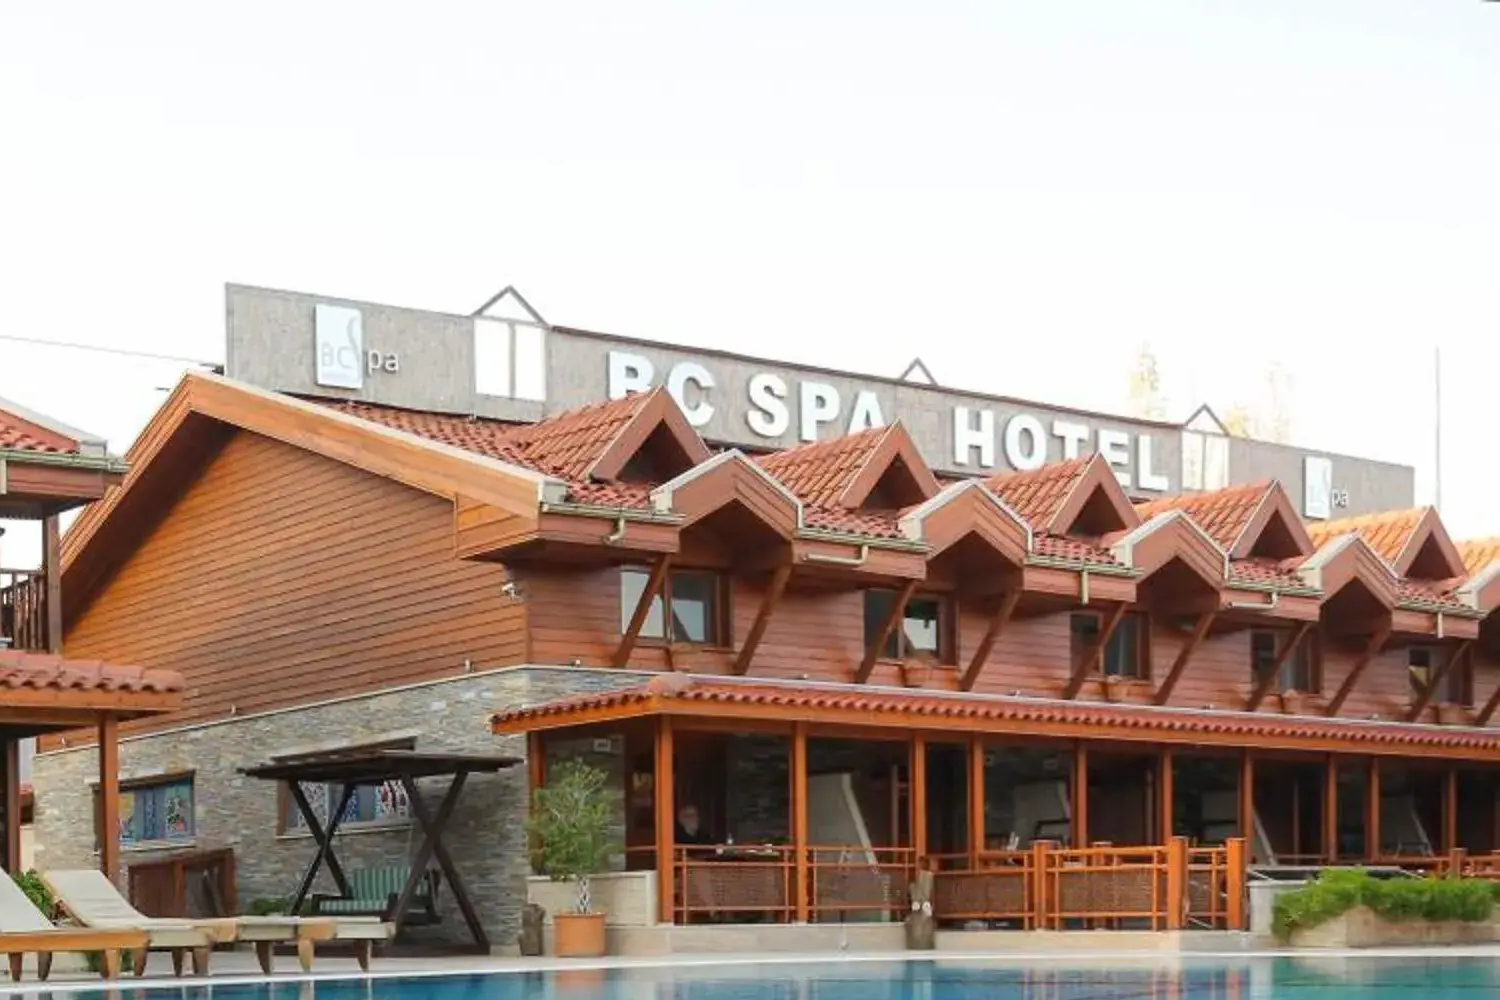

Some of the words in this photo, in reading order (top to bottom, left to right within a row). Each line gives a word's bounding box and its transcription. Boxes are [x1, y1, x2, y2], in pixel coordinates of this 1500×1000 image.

[608, 350, 716, 427] BC
[747, 373, 885, 441] SPA
[953, 406, 1169, 491] HOTEL
